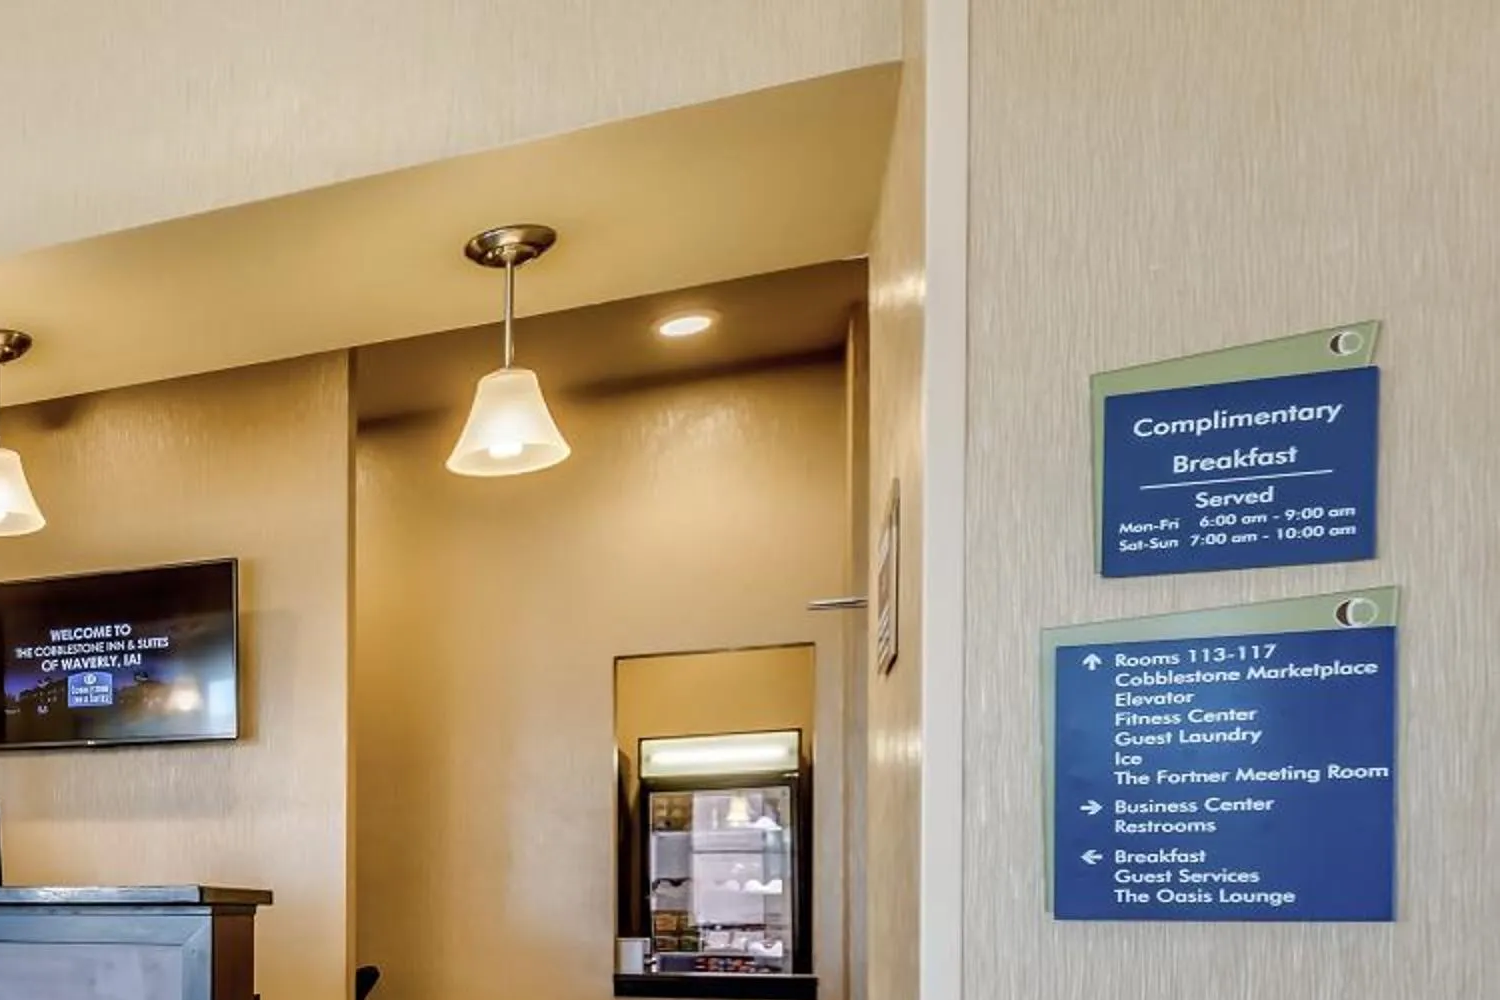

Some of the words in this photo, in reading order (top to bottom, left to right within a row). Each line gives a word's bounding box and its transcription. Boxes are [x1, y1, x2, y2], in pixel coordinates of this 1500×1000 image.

[1133, 403, 1343, 437] Complimentary
[1173, 446, 1298, 474] Breakfast
[1195, 486, 1274, 509] Served
[1119, 517, 1179, 534] Mon-Fri
[1199, 513, 1237, 528] 6:00
[1241, 514, 1267, 525] am
[1284, 508, 1323, 521] 9:00
[1328, 507, 1356, 517] am
[1119, 538, 1179, 552] Sat-Sun
[1190, 533, 1227, 547] 7:00
[1231, 533, 1257, 543] am
[1277, 525, 1324, 541] 10:00
[1328, 525, 1356, 535] am
[50, 627, 113, 642] WELCOME
[114, 623, 132, 637] TO
[15, 647, 33, 659] THE
[34, 640, 105, 658] COBBLESTONE
[106, 640, 125, 651] INN
[137, 636, 169, 649] SUITES
[1114, 653, 1181, 668] Rooms
[1187, 643, 1277, 664] 113-117
[41, 660, 59, 672] OF
[61, 655, 121, 670] WAVERLY,
[1114, 670, 1240, 688] Cobblestone
[1246, 661, 1379, 681] Marketplace
[1114, 692, 1195, 707] Elevator
[1114, 712, 1182, 727] Fitness
[1187, 708, 1258, 724] Center
[1114, 731, 1173, 747] Guest
[1179, 727, 1263, 746] Laundry
[1114, 751, 1143, 766] Ice
[1113, 770, 1150, 786] The
[1235, 765, 1321, 783] Meeting
[1327, 764, 1390, 779] Room
[1114, 799, 1198, 815] Business
[1203, 797, 1276, 812] Center
[1114, 819, 1217, 834] Restrooms
[1114, 849, 1206, 864] Breakfast
[1114, 869, 1173, 884] Guest
[1179, 868, 1261, 884] Services
[1113, 889, 1150, 904] The
[1156, 888, 1213, 904] Oasis
[1219, 888, 1297, 907] Lounge
